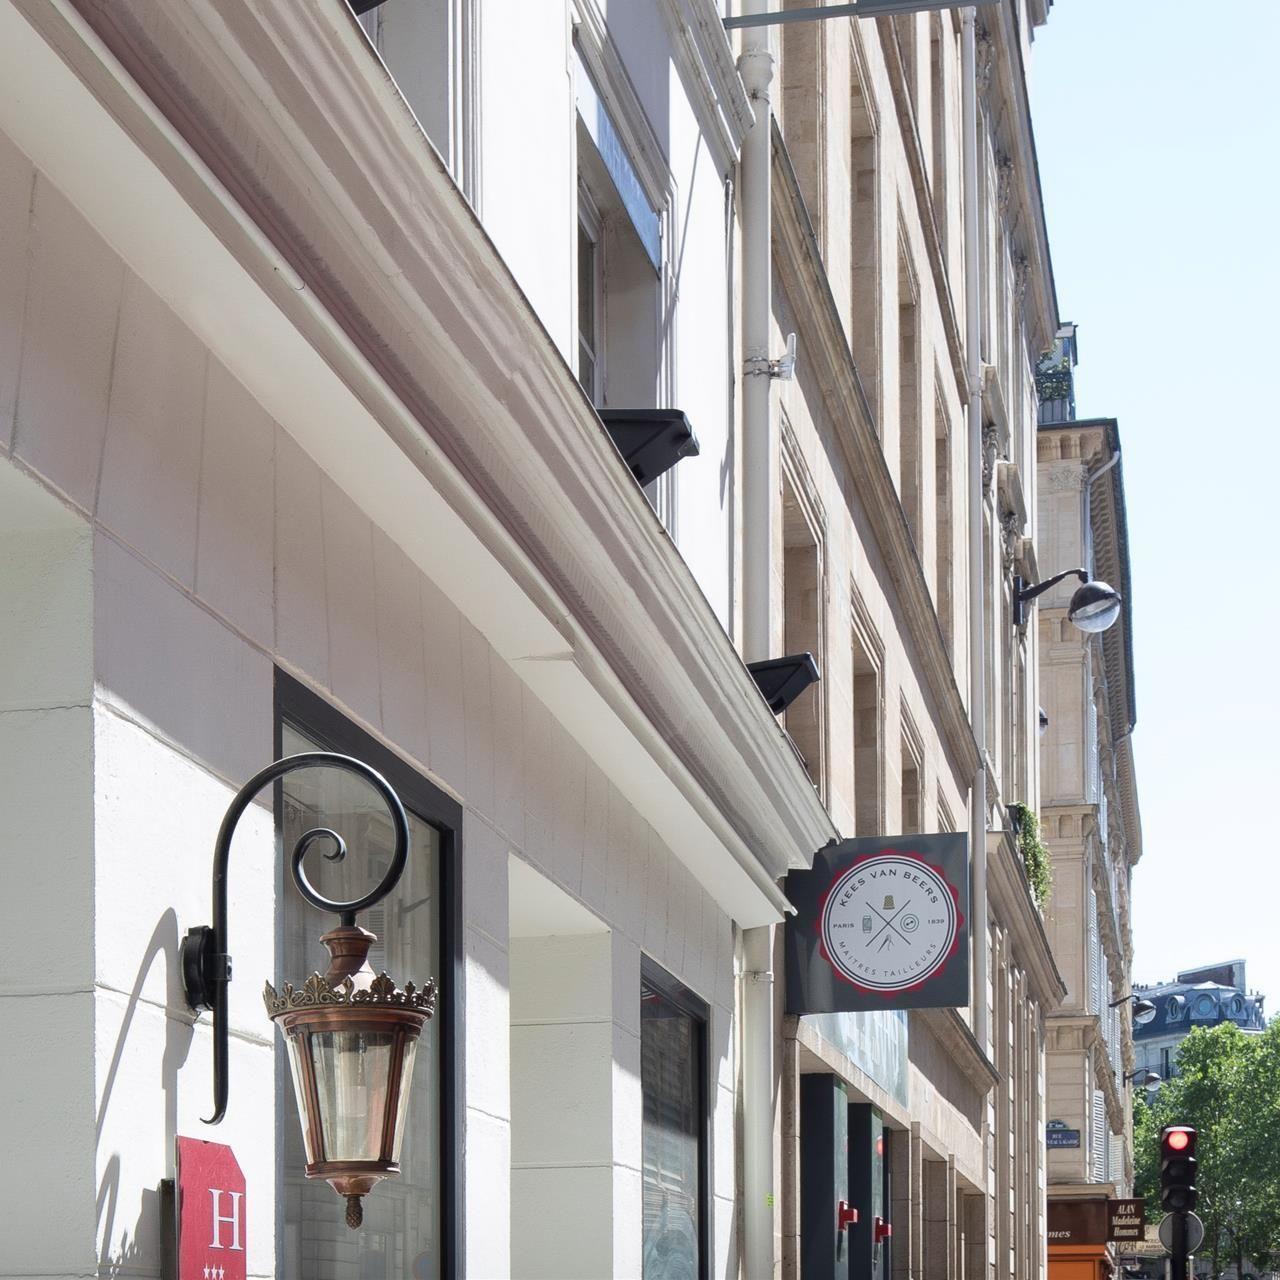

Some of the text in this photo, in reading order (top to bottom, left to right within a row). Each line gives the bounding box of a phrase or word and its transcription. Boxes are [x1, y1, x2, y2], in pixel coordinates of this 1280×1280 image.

[839, 869, 939, 907] KEES VAN BEERS
[884, 943, 937, 977] TAILLEURS
[208, 1188, 244, 1250] H
[1117, 1205, 1136, 1214] ALAN
